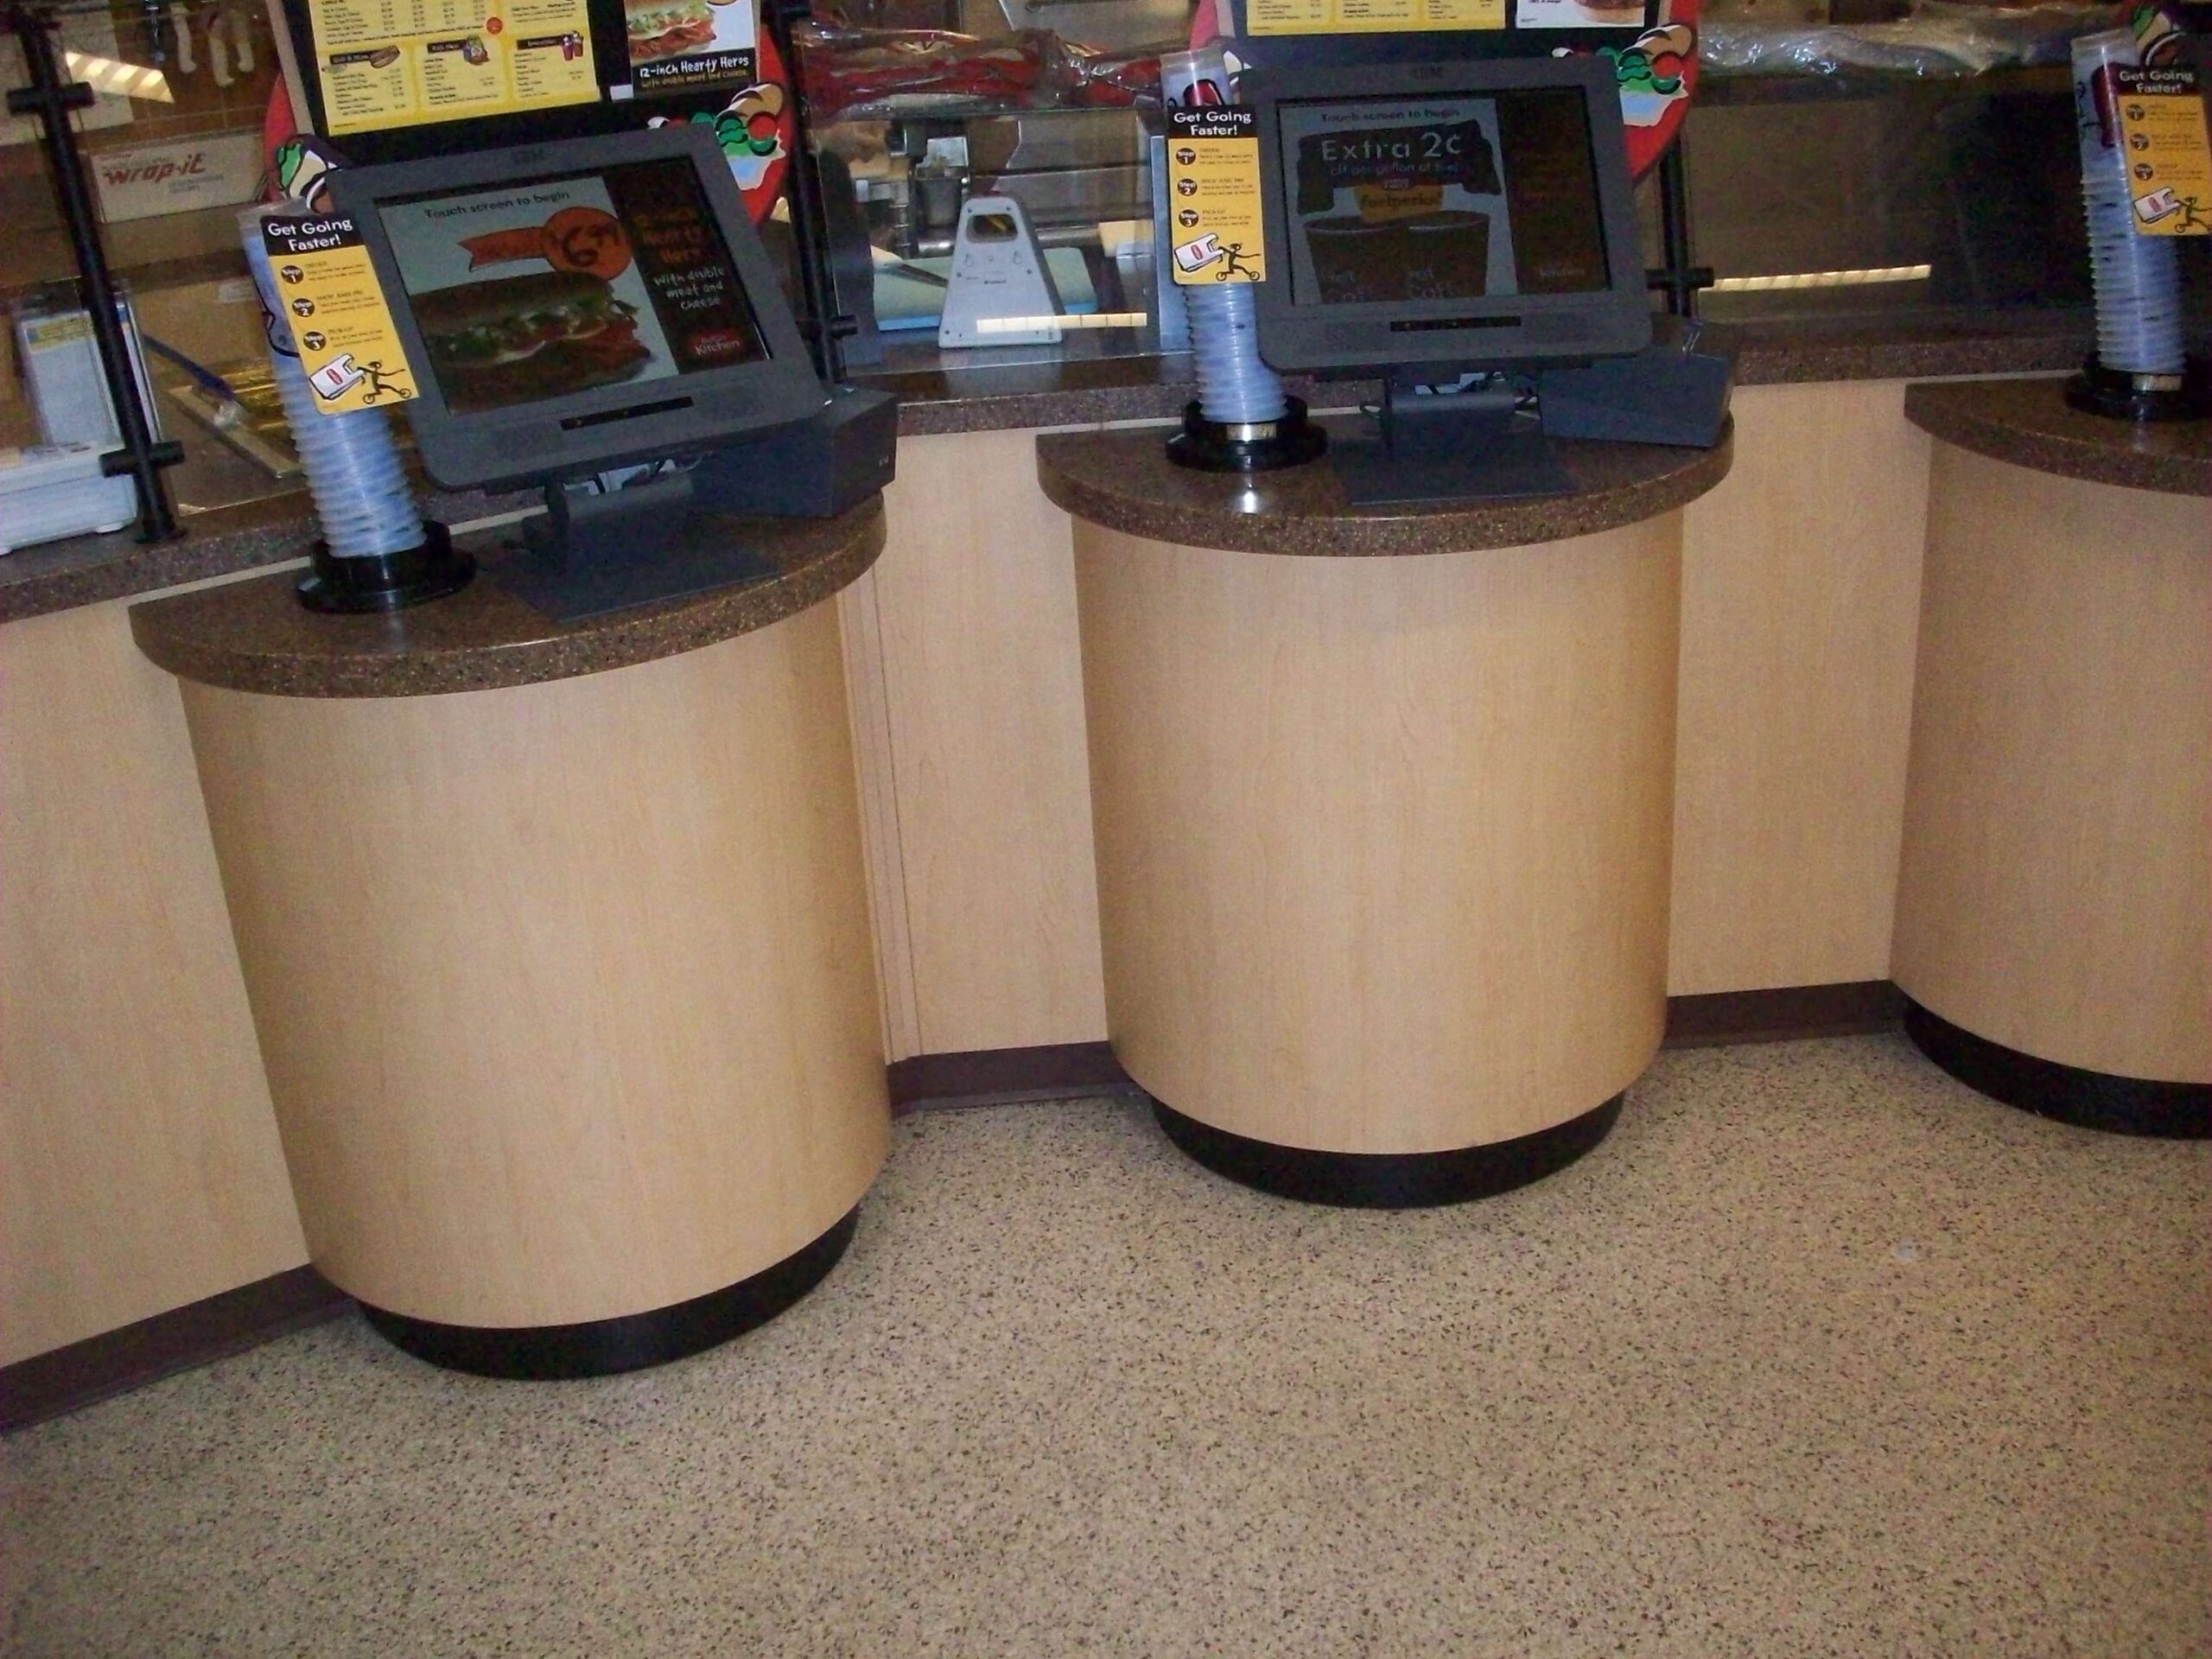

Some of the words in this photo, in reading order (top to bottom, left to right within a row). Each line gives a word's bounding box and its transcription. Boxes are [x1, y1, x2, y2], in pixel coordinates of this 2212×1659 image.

[639, 65, 678, 79] 12-inch
[680, 58, 717, 73] Hearty
[720, 56, 749, 68] Heros
[2119, 70, 2145, 82] Get
[2150, 69, 2194, 83] Going
[2136, 83, 2182, 94] Faster!
[1173, 111, 1201, 124] Get
[1205, 111, 1252, 124] Going
[1190, 124, 1237, 136] Faster!
[1321, 140, 1410, 161] Extra
[424, 207, 467, 219] Touch
[471, 200, 513, 214] screen
[517, 195, 531, 206] to
[533, 190, 571, 204] begin
[267, 222, 297, 237] Get
[301, 218, 354, 235] Going
[287, 233, 342, 251] Faster!
[666, 284, 699, 299] meat
[703, 281, 724, 294] and
[301, 308, 309, 316] 2
[312, 341, 321, 350] 3
[694, 340, 741, 357] Kitchen
